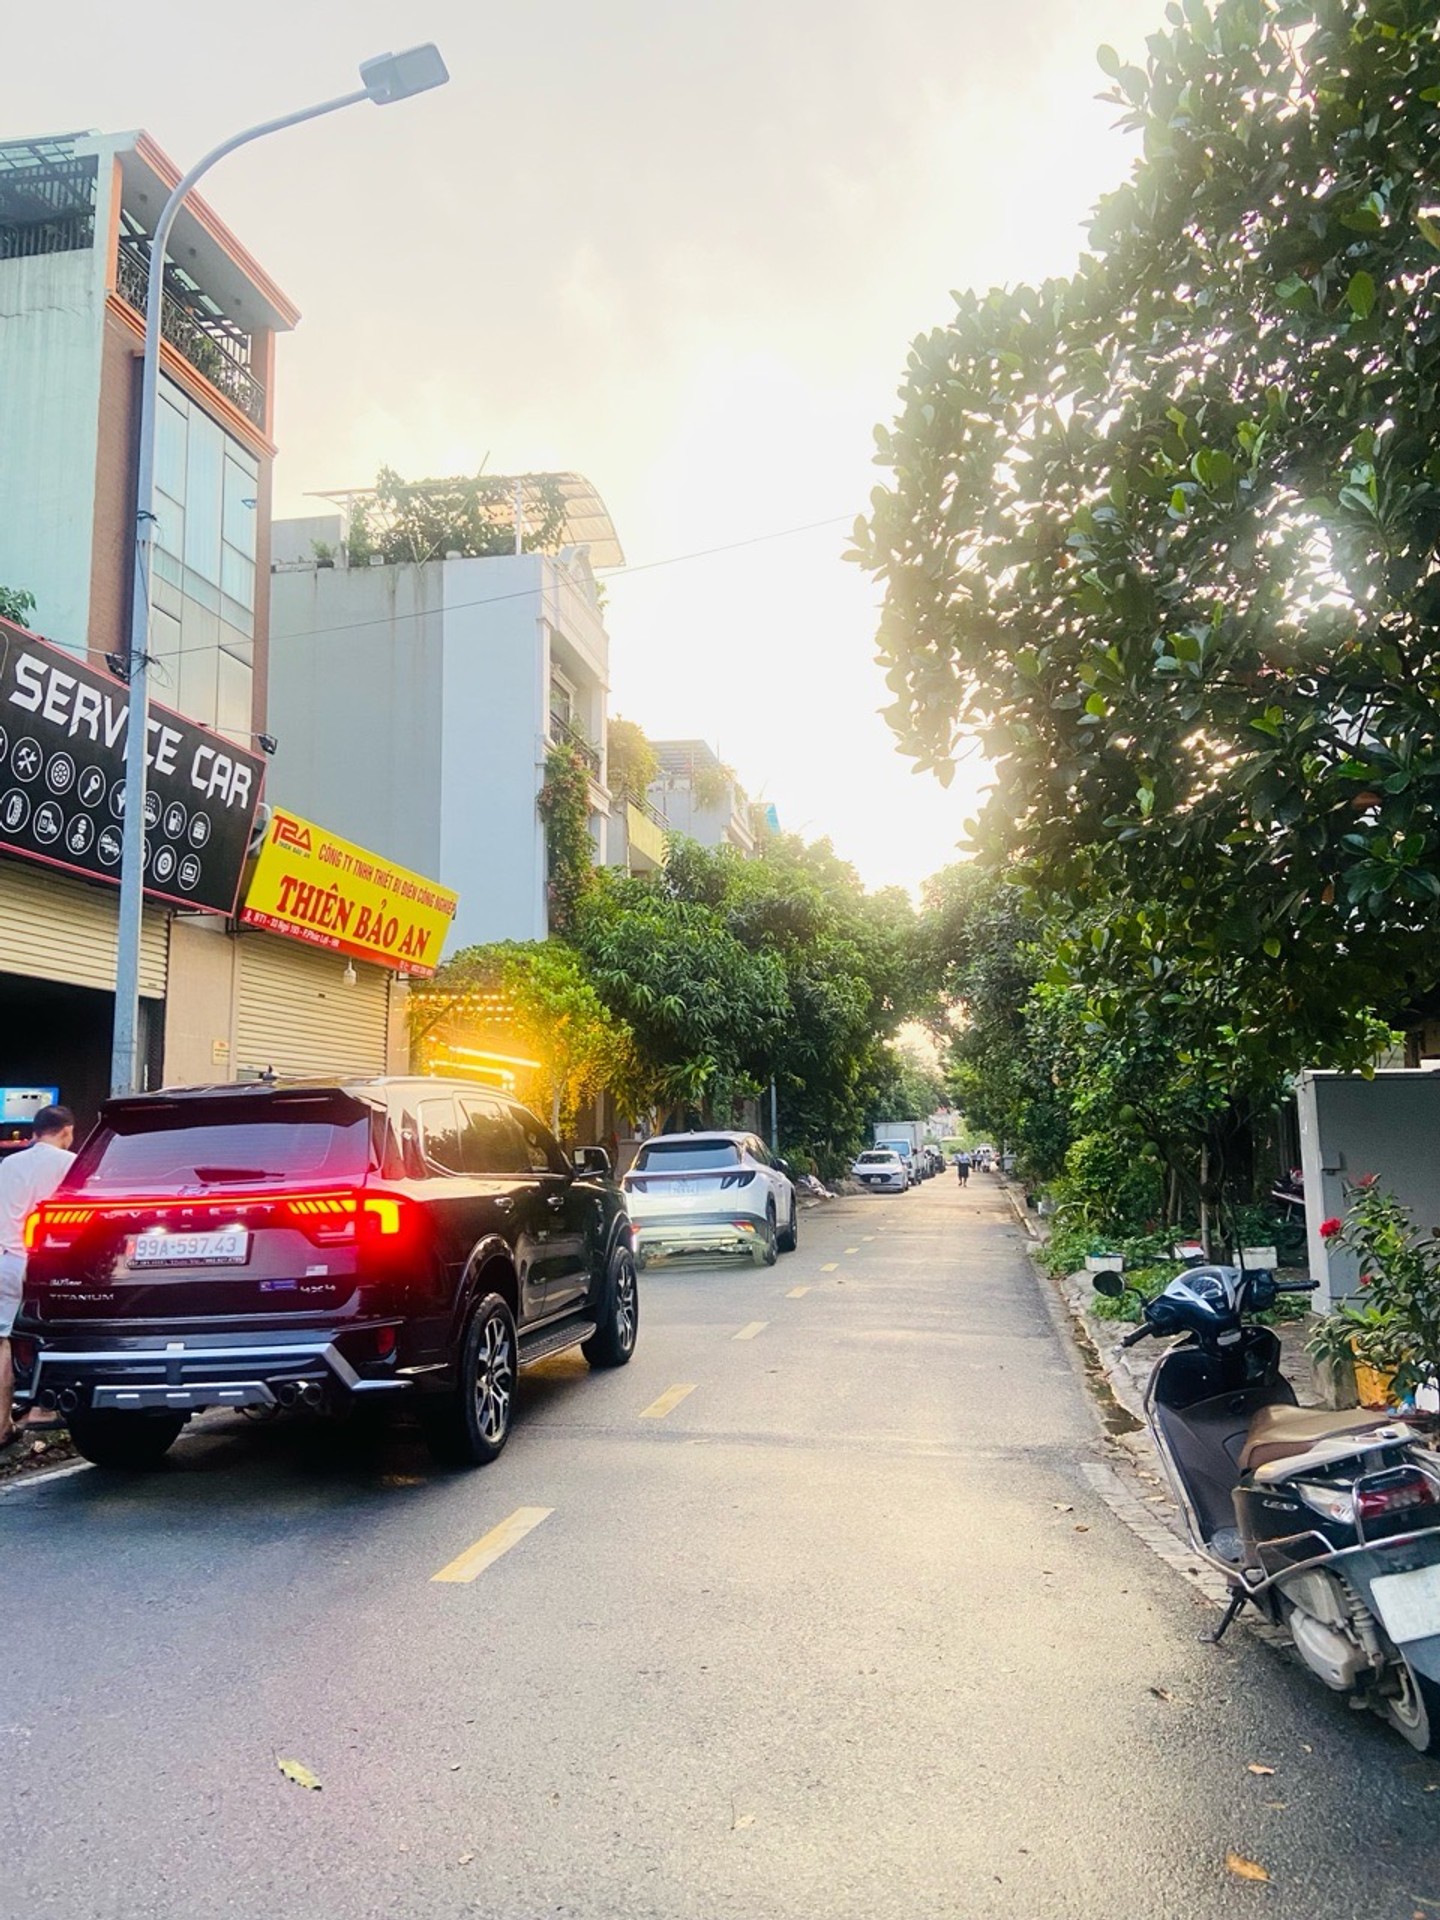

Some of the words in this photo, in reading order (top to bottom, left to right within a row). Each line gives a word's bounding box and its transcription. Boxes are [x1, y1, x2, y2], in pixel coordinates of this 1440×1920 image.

[9, 652, 184, 776] SERVE
[191, 744, 252, 809] CAR
[318, 843, 343, 868] CÔNG
[342, 854, 354, 873] TY
[353, 859, 375, 881] TNHH
[276, 874, 355, 934] THIÊN
[353, 898, 399, 949] BẢO
[398, 924, 431, 959] AN
[138, 1237, 237, 1257] 99A-597.43
[49, 1293, 114, 1301] TITANIUM
